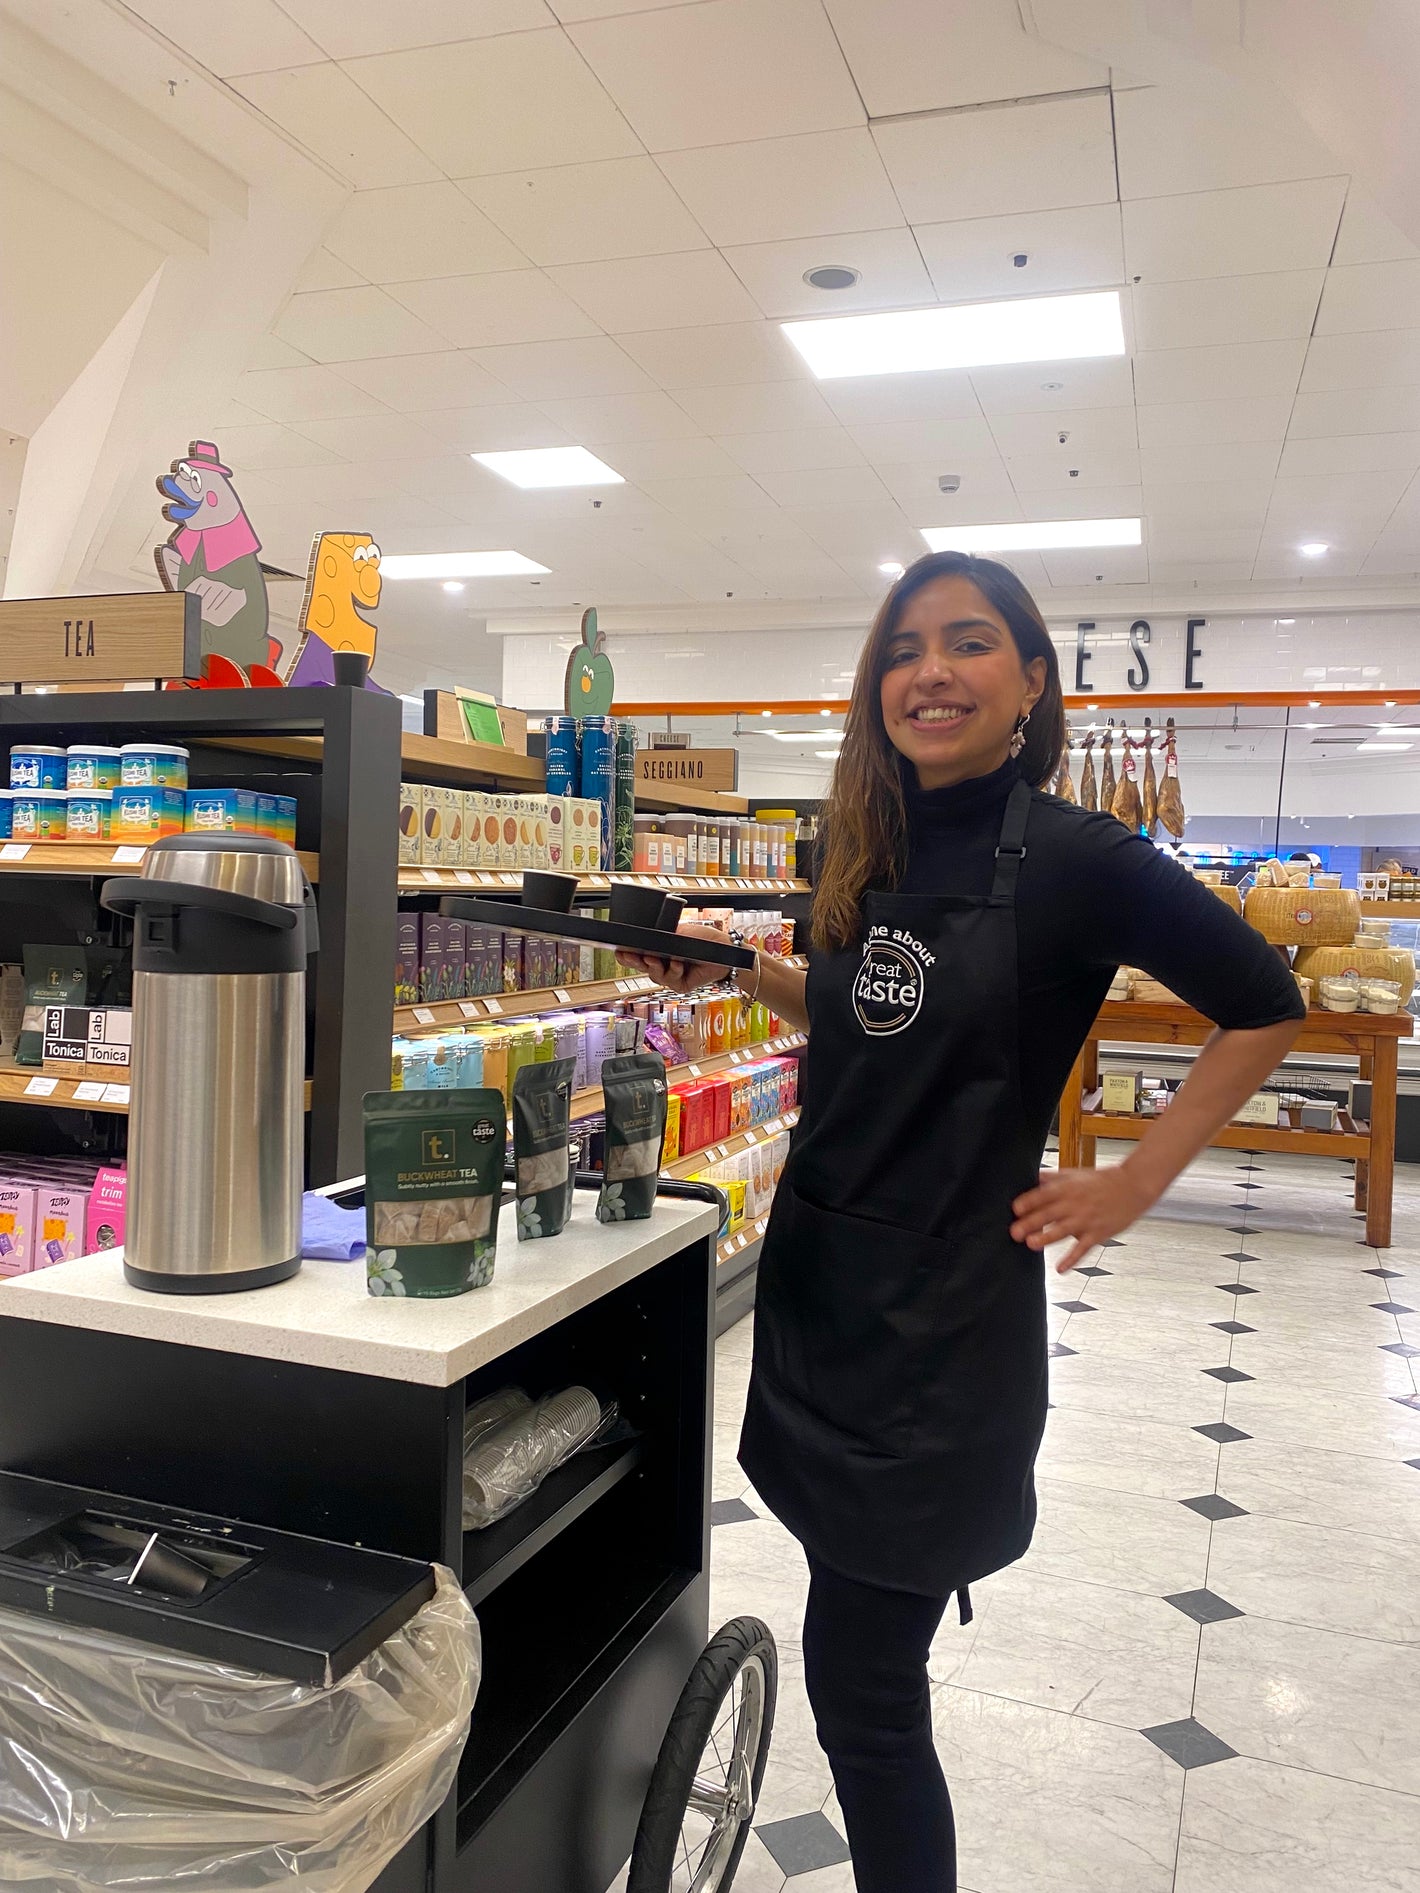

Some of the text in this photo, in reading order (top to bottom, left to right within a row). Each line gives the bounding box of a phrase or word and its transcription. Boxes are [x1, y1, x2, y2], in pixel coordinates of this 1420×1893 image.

[63, 620, 95, 657] TEA
[23, 768, 34, 777] TEA
[80, 769, 89, 778] TEA
[137, 768, 148, 777] TEA
[643, 760, 704, 779] SEGGIANO
[82, 814, 94, 823] TEA
[892, 928, 937, 967] about
[868, 961, 902, 979] reat
[857, 973, 917, 1008] taste
[47, 1010, 60, 1038] Lab
[91, 1014, 103, 1041] Lab
[47, 1042, 84, 1058] Tonica
[90, 1046, 127, 1062] Tonica
[473, 1127, 495, 1136] taste
[397, 1168, 478, 1182] BUCKWHEAT TEA
[100, 1186, 123, 1200] trim
